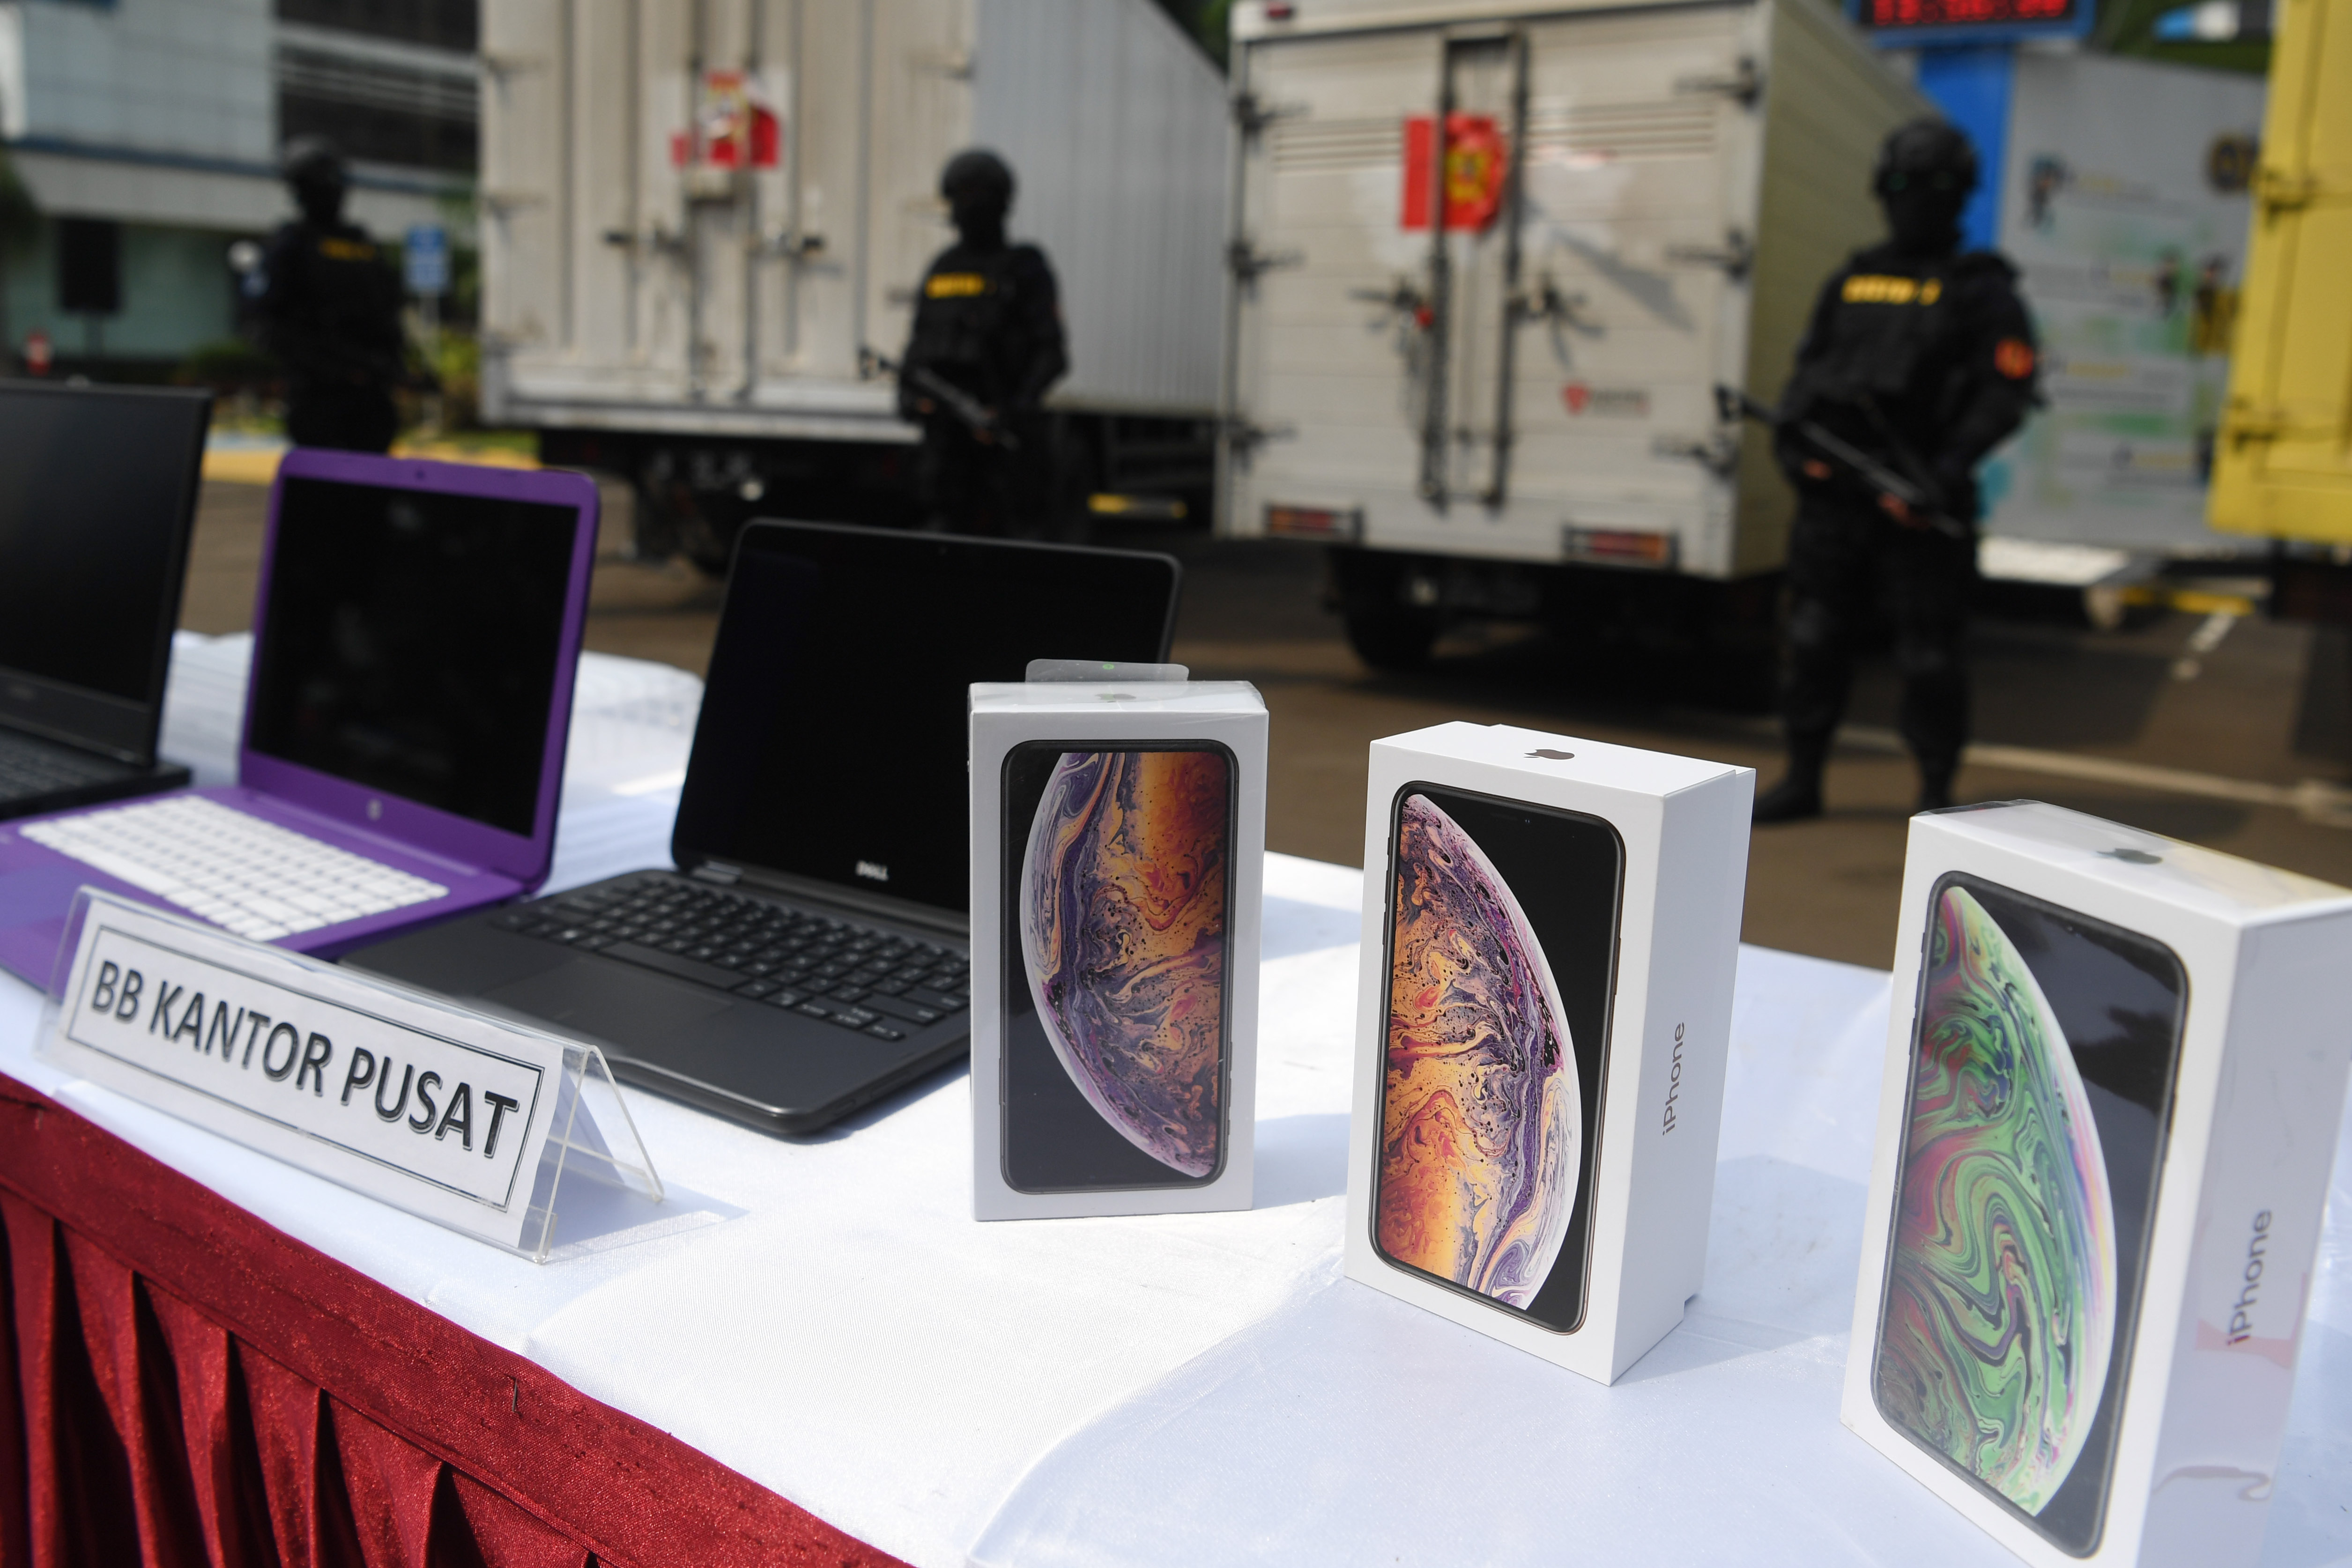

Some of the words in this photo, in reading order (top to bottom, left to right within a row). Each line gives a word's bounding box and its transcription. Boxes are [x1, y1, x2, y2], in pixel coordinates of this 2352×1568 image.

[91, 959, 144, 1022] BB
[149, 980, 334, 1098] KANTOR
[340, 1046, 520, 1159] PUSAT
[1662, 1021, 1685, 1137] iPhone
[2226, 1208, 2272, 1347] iPhone
